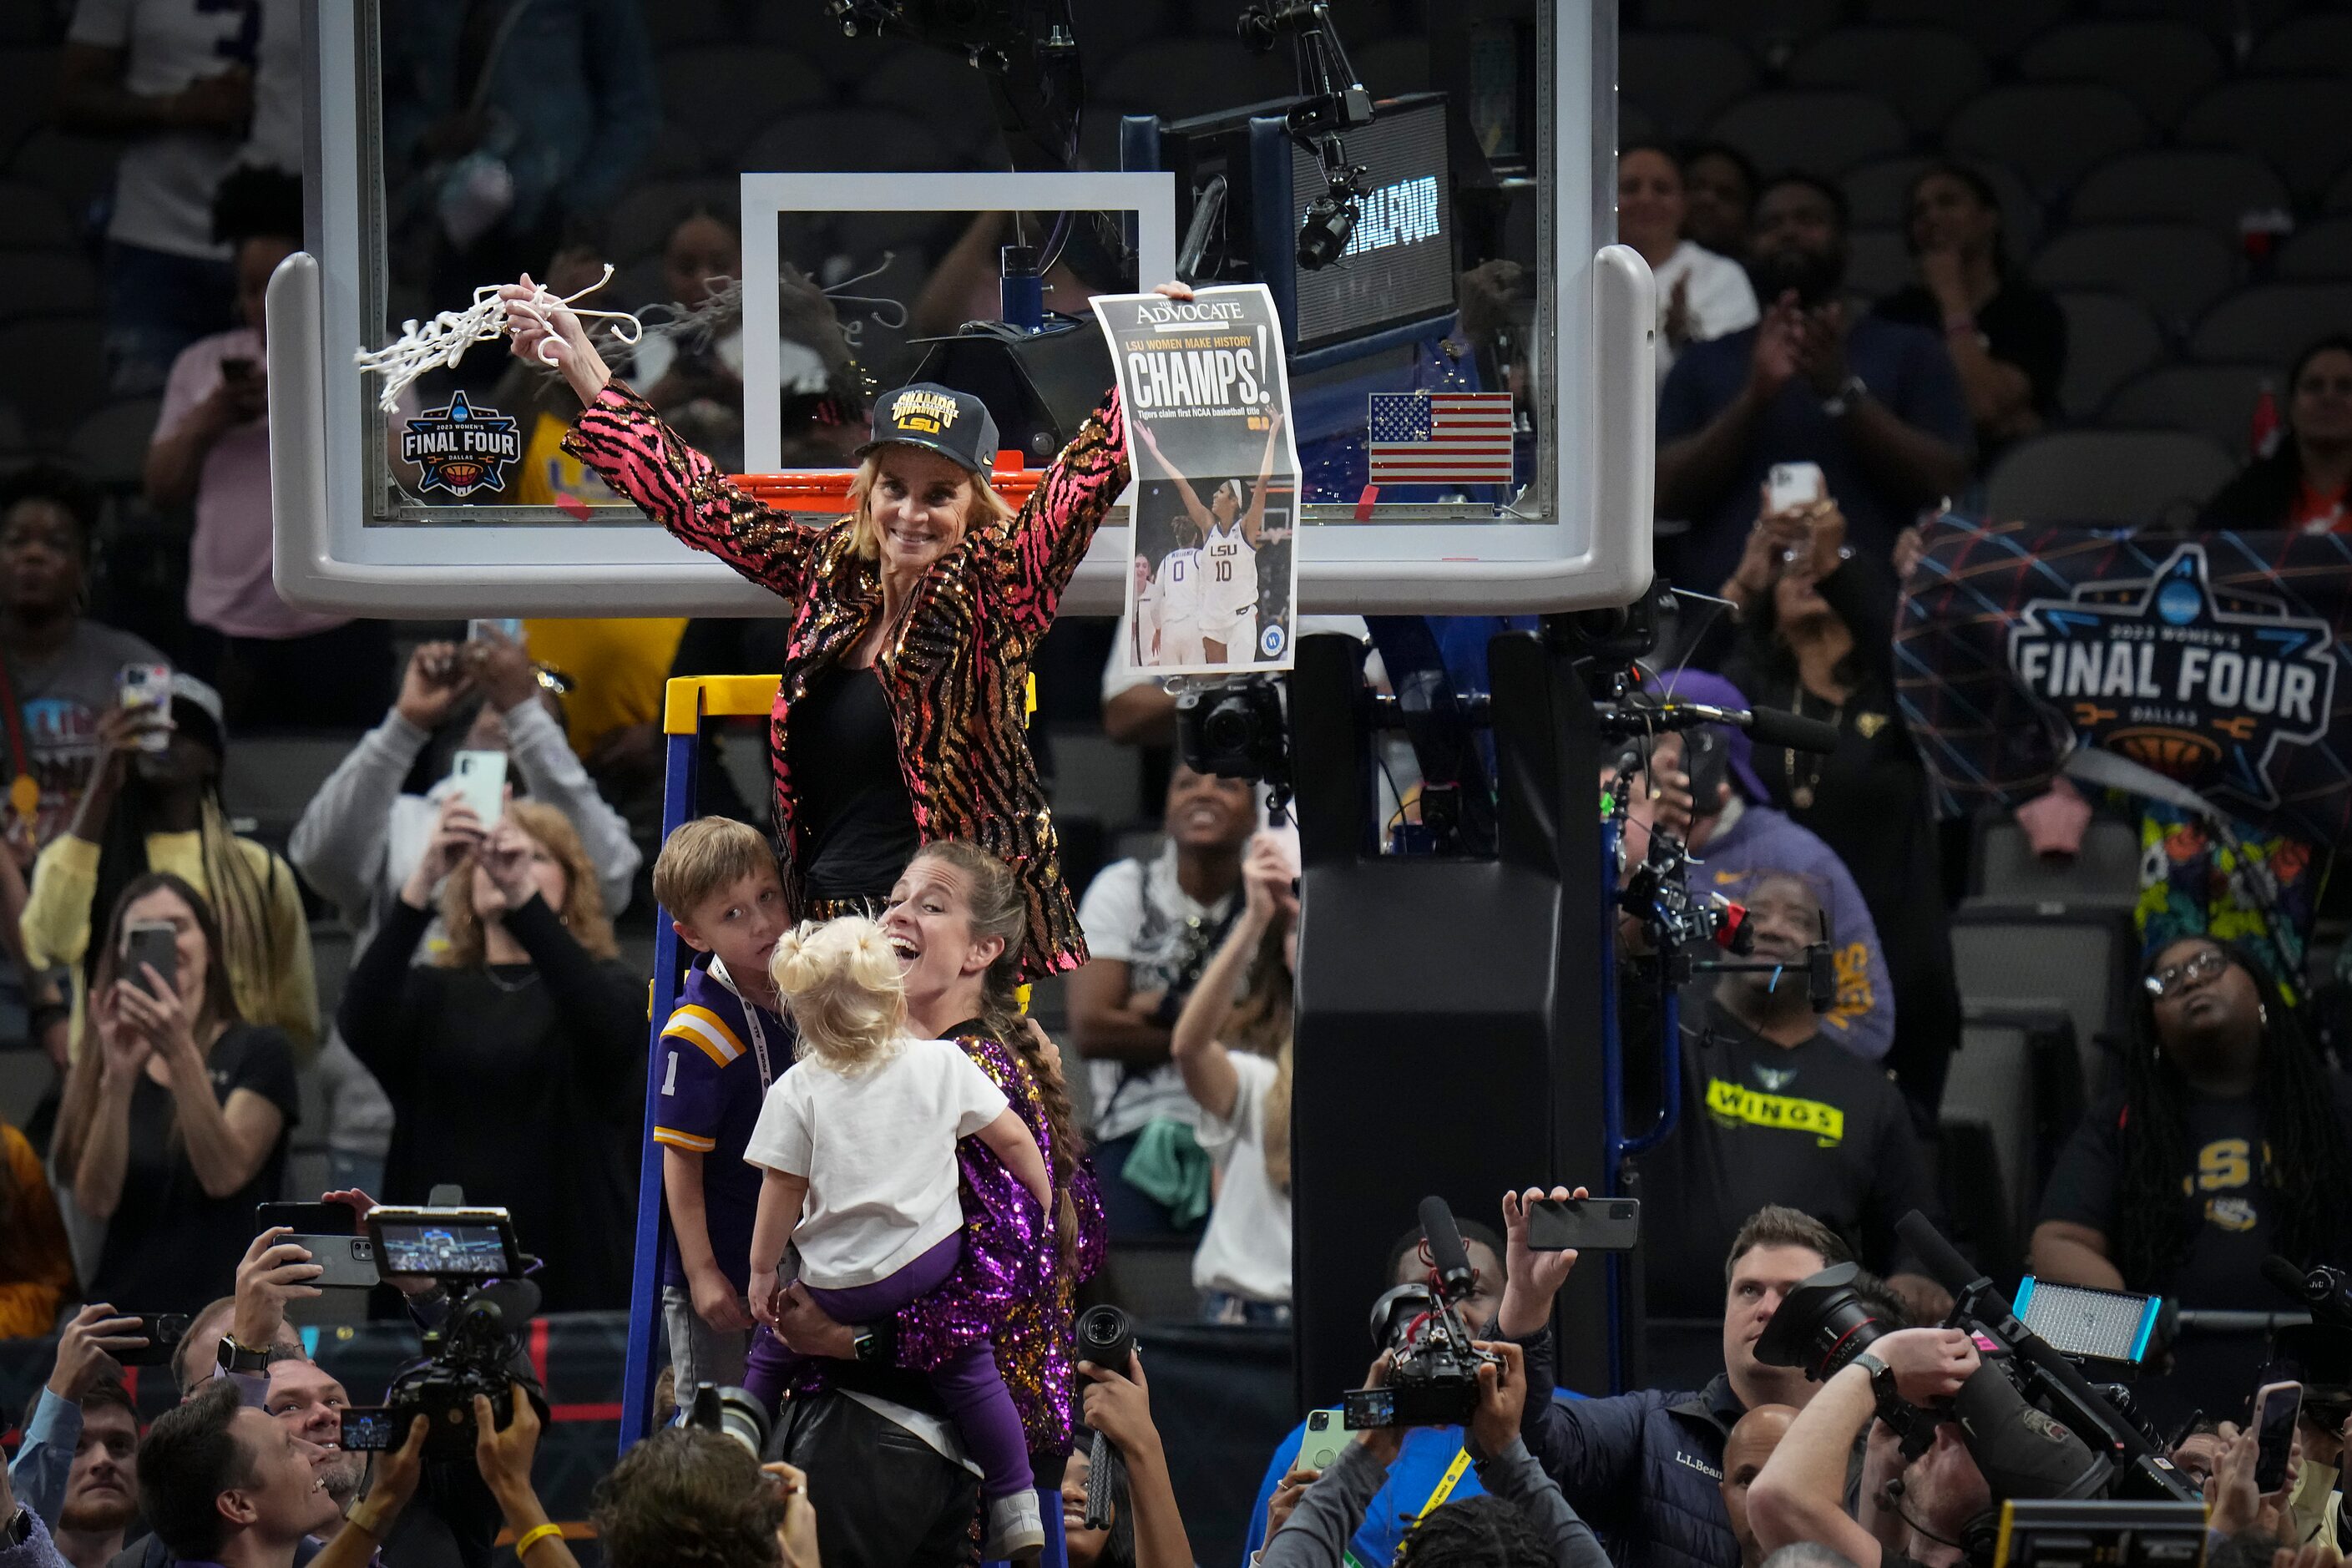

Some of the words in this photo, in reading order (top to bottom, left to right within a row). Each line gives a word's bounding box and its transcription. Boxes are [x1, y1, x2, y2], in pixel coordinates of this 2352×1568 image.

[1136, 302, 1244, 324] ADVOCATE
[1125, 340, 1145, 352] LSU
[1146, 338, 1183, 350] WOMEN
[1185, 336, 1211, 348] MAKE
[1214, 336, 1252, 347] HISTORY
[1128, 325, 1271, 408] CHAMPS!
[1137, 410, 1158, 421] Tigers
[1159, 409, 1176, 418] claim
[1177, 408, 1191, 417] first
[1192, 407, 1211, 417] NCAA
[1212, 407, 1245, 416] basketball
[1246, 406, 1260, 416] title
[898, 417, 941, 433] LSU
[406, 431, 458, 456] FINAL
[464, 432, 514, 456] FOUR
[1211, 544, 1237, 557] LSU
[1173, 560, 1184, 581] 0
[1216, 560, 1232, 581] 10
[2021, 640, 2162, 699] FINAL
[2176, 646, 2317, 724] FOUR
[661, 1050, 679, 1096] 1
[1720, 1090, 1831, 1128] WINGS
[1676, 1450, 1723, 1480] L.L.Bean
